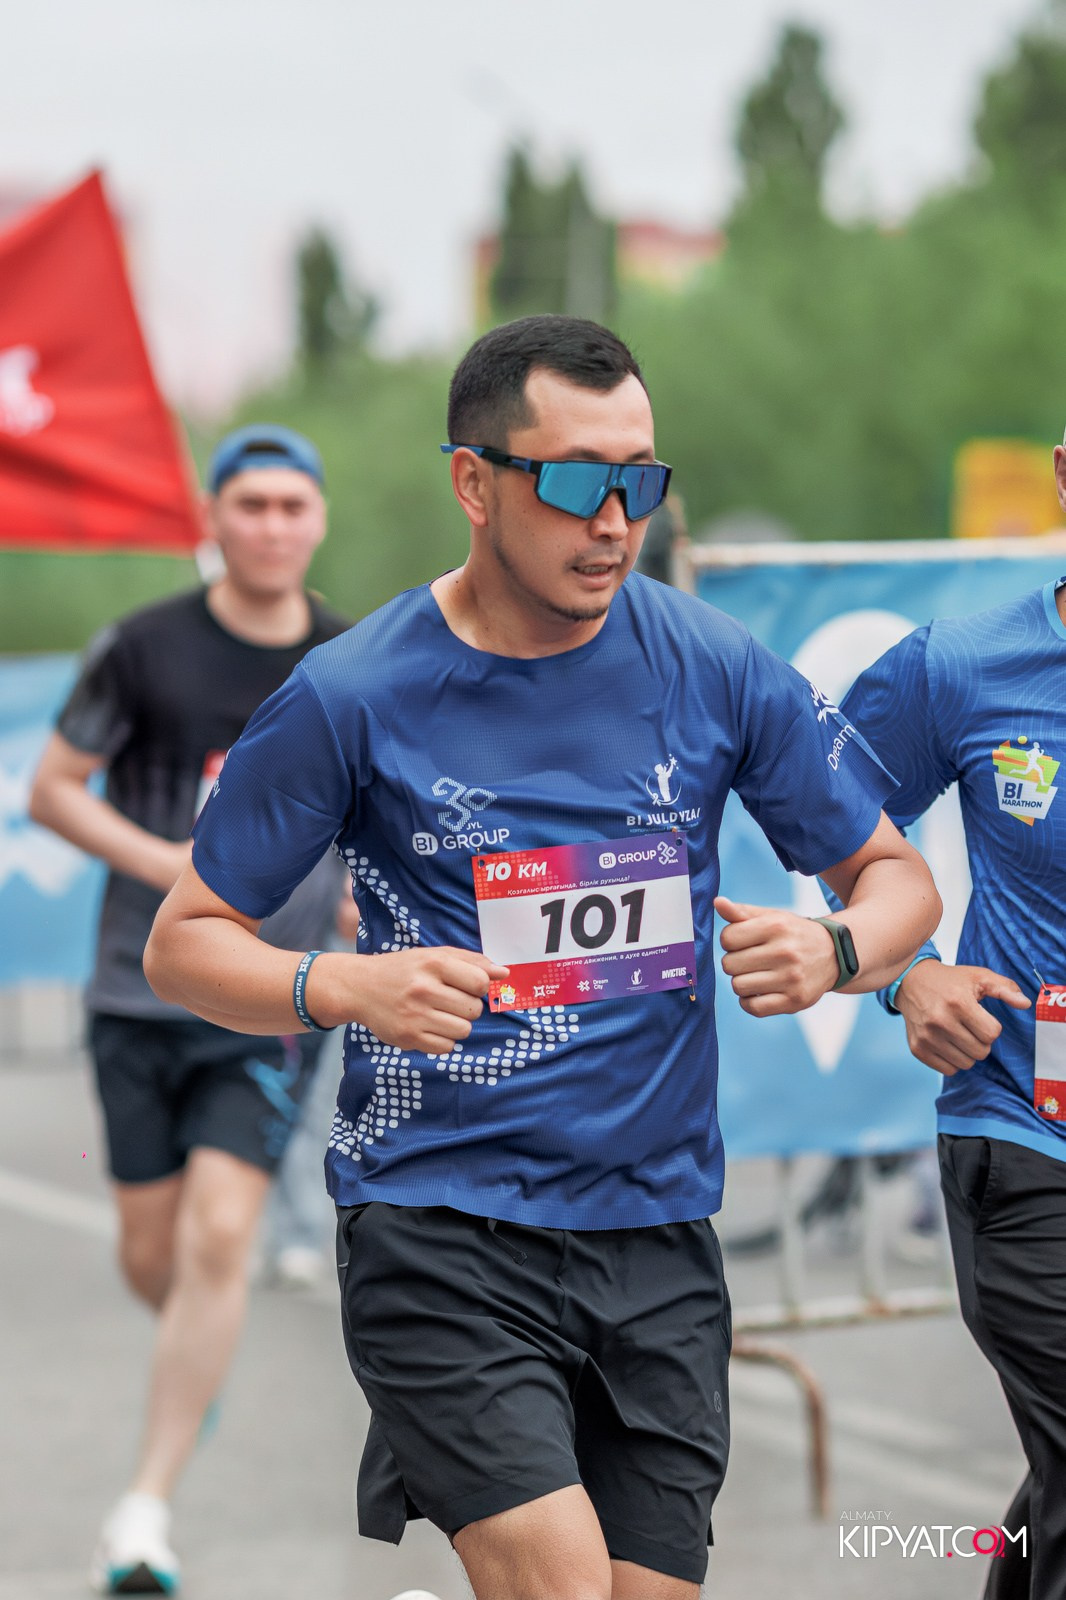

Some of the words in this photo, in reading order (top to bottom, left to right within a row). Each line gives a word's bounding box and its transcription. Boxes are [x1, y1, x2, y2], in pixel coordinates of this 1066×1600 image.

[827, 724, 857, 771] Dream
[1004, 782, 1023, 799] BI
[1001, 798, 1043, 809] MARATHON
[466, 821, 483, 830] JYL
[627, 815, 642, 826] BI
[414, 836, 434, 852] BI
[442, 827, 510, 850] GROUP
[617, 848, 657, 864] GROUP
[485, 861, 512, 882] 10
[579, 879, 599, 889] бірлік
[600, 875, 631, 886] рухында!
[540, 888, 646, 954] 101
[562, 959, 583, 969] ритме
[584, 955, 618, 967] движения,
[625, 952, 640, 961] духе
[642, 947, 669, 957] единства!
[661, 967, 687, 980] INVICTUS
